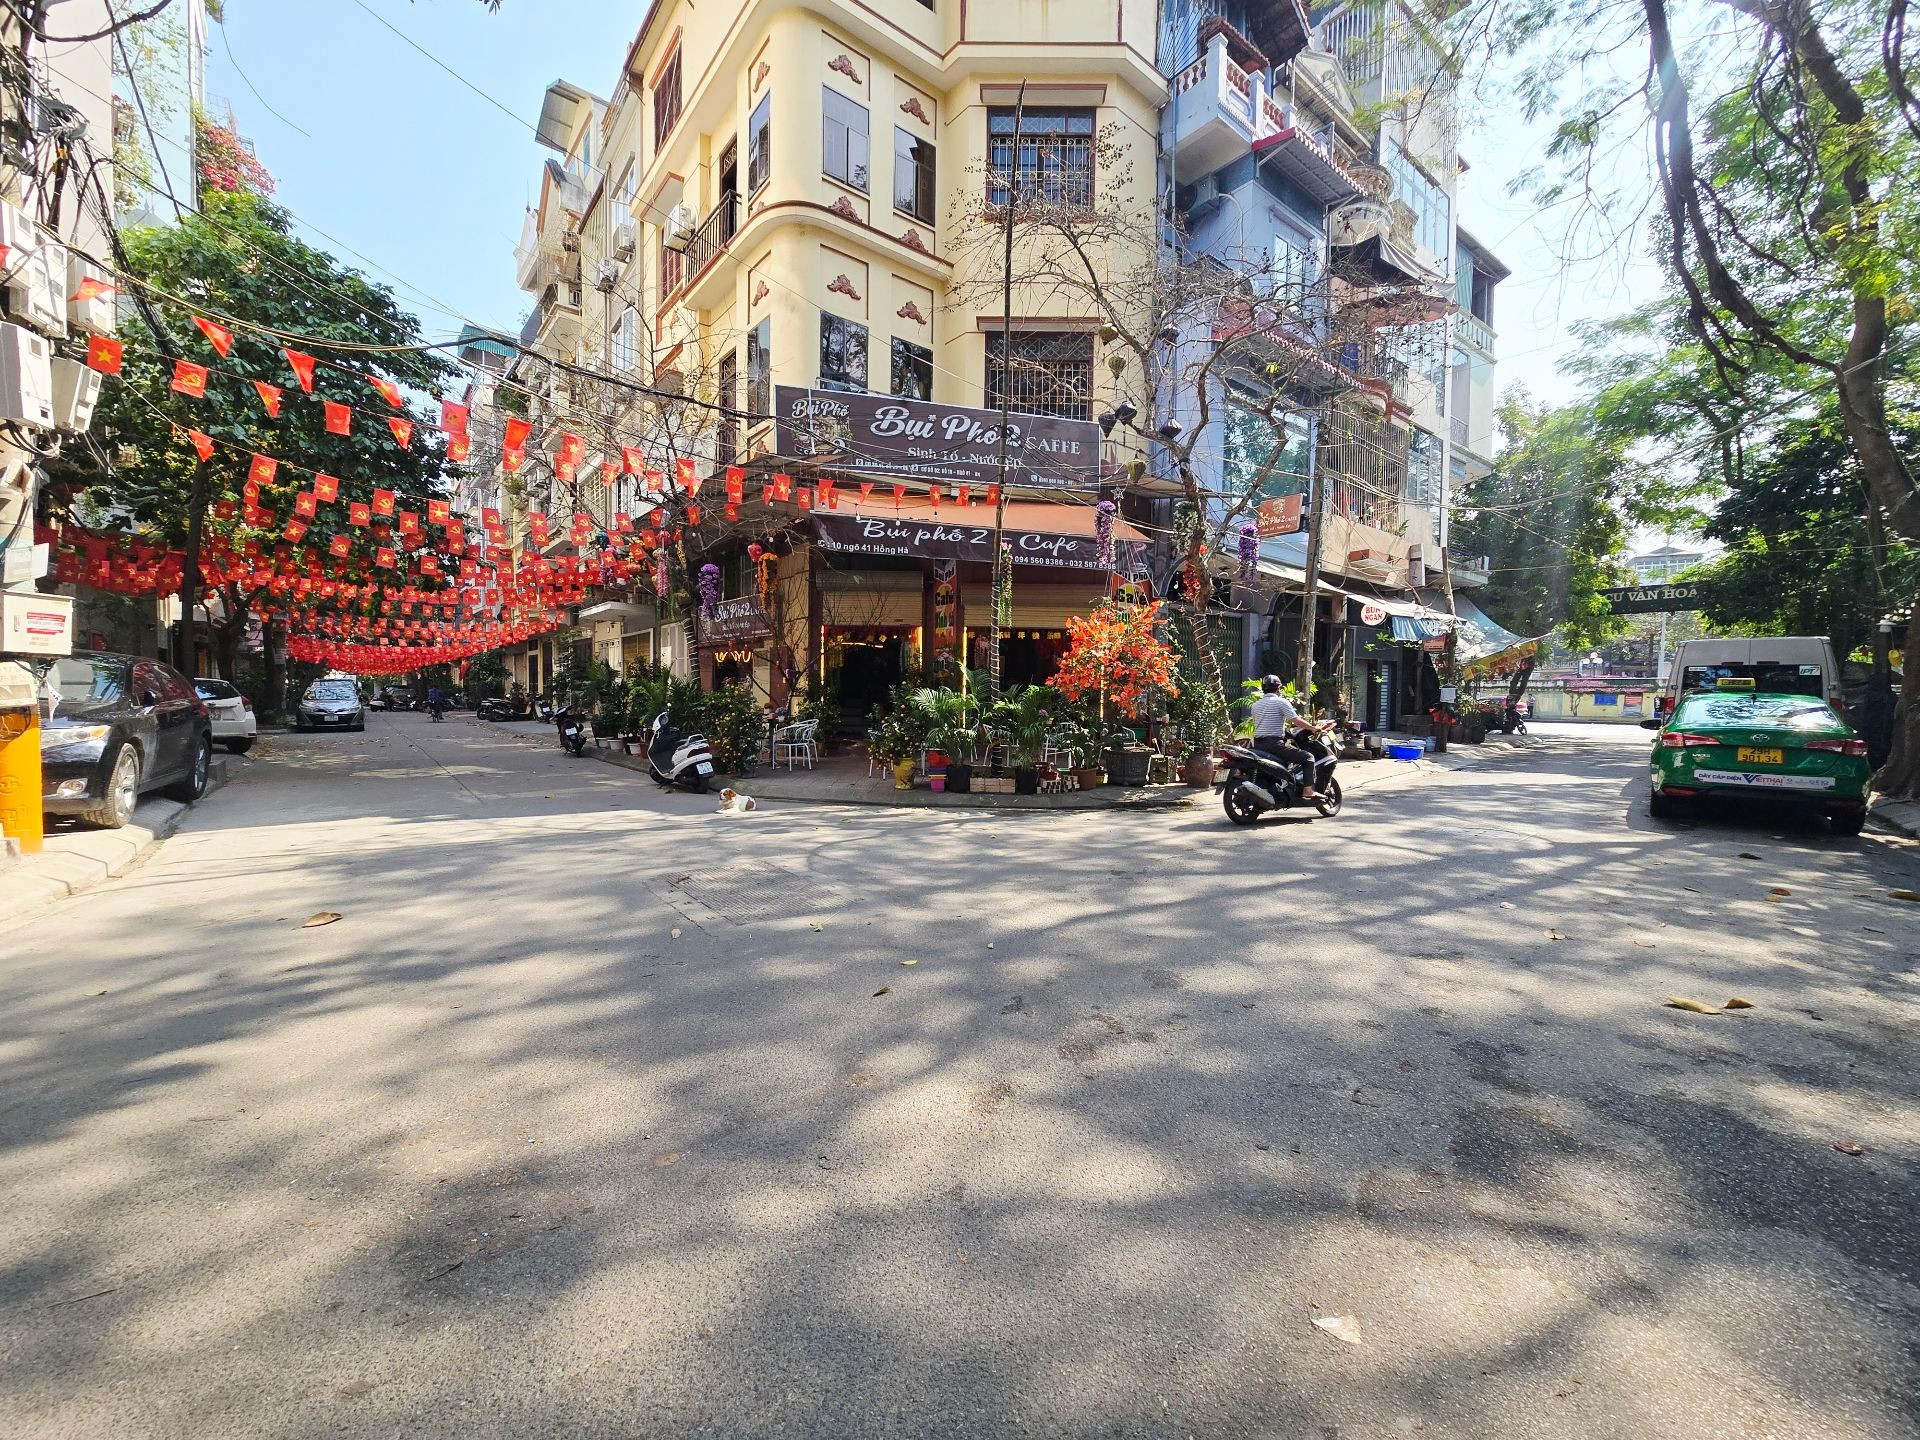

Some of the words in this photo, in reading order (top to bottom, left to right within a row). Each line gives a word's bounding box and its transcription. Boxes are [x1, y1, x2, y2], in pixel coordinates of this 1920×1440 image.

[870, 406, 936, 441] Bụi
[1005, 424, 1021, 447] 2
[1024, 436, 1081, 455] CAFFE
[907, 447, 937, 460] Sinh
[856, 519, 911, 539] Bụi
[914, 526, 965, 546] phố
[970, 529, 989, 545] 2
[1019, 534, 1080, 557] Café
[832, 541, 842, 550] 10
[861, 544, 872, 552] 41
[873, 544, 896, 555] Hồng
[1030, 556, 1044, 565] 560
[1045, 557, 1064, 566] 8386
[1069, 559, 1083, 568] 032
[1084, 561, 1098, 569] 587
